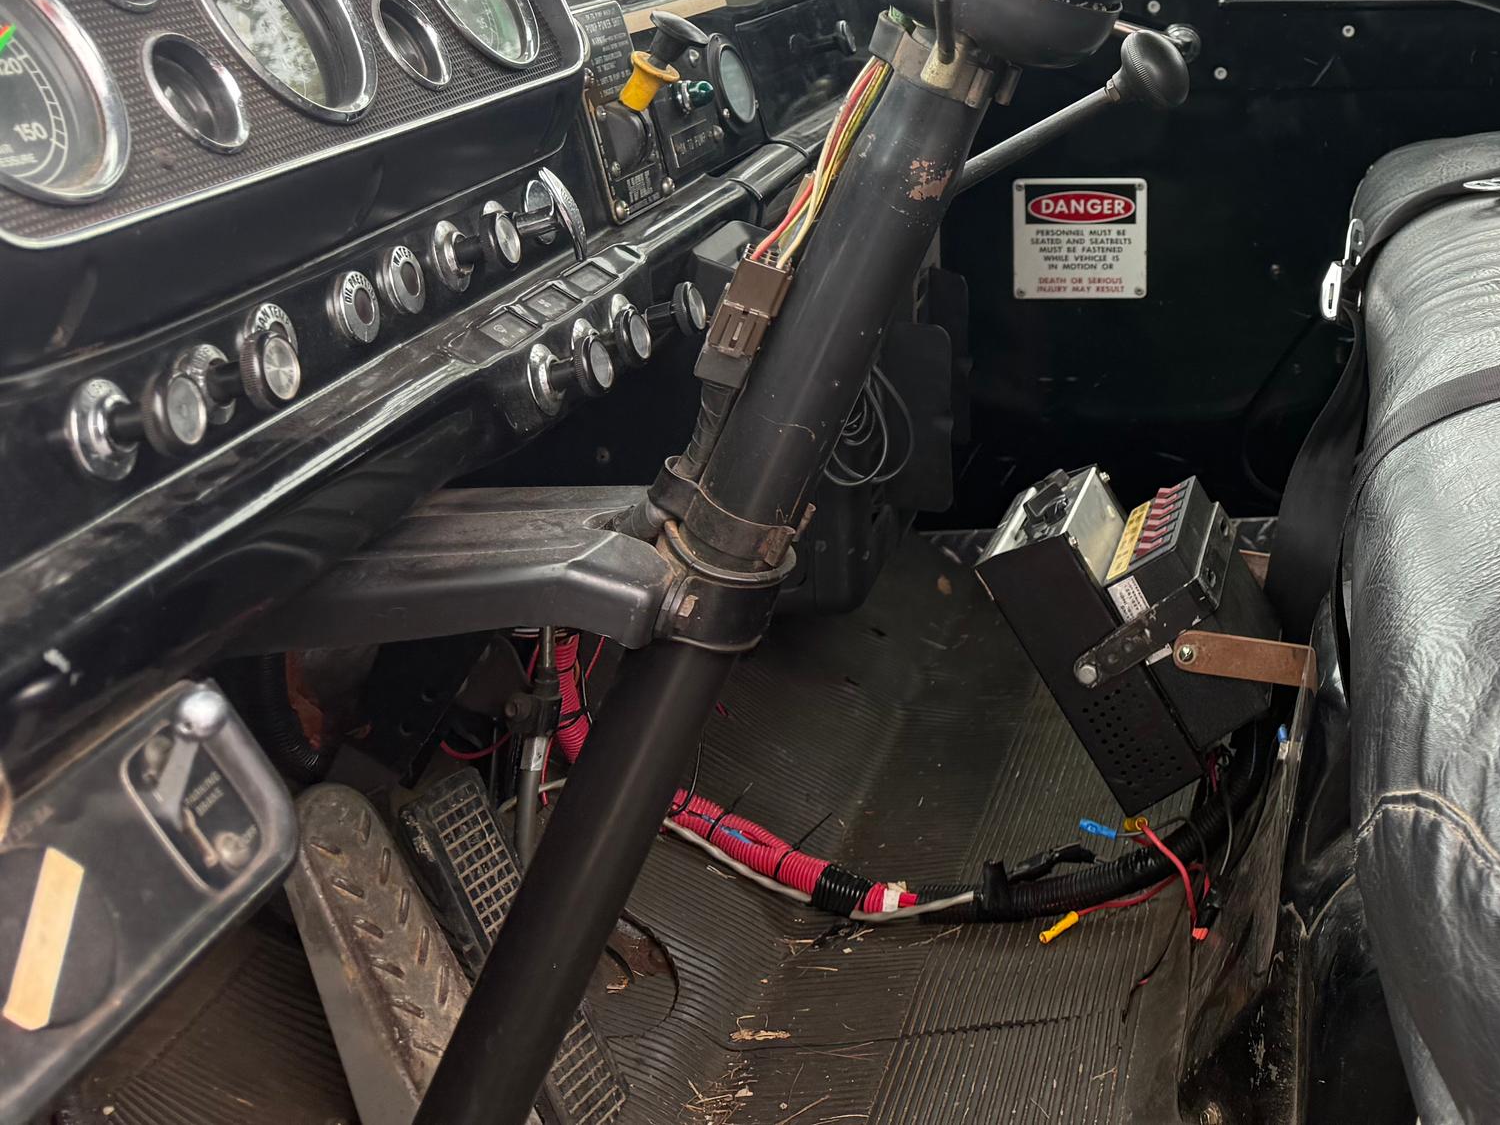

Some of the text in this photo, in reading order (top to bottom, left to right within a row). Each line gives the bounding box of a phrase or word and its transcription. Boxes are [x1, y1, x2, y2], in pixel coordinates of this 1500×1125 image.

[0, 58, 22, 75] 20
[13, 122, 48, 142] 150
[1040, 198, 1125, 215] DANGER
[393, 247, 411, 266] WATER
[345, 288, 353, 304] OIL
[1072, 285, 1090, 293] MAY
[1096, 285, 1124, 293] RESULT
[195, 786, 224, 817] BRAKE
